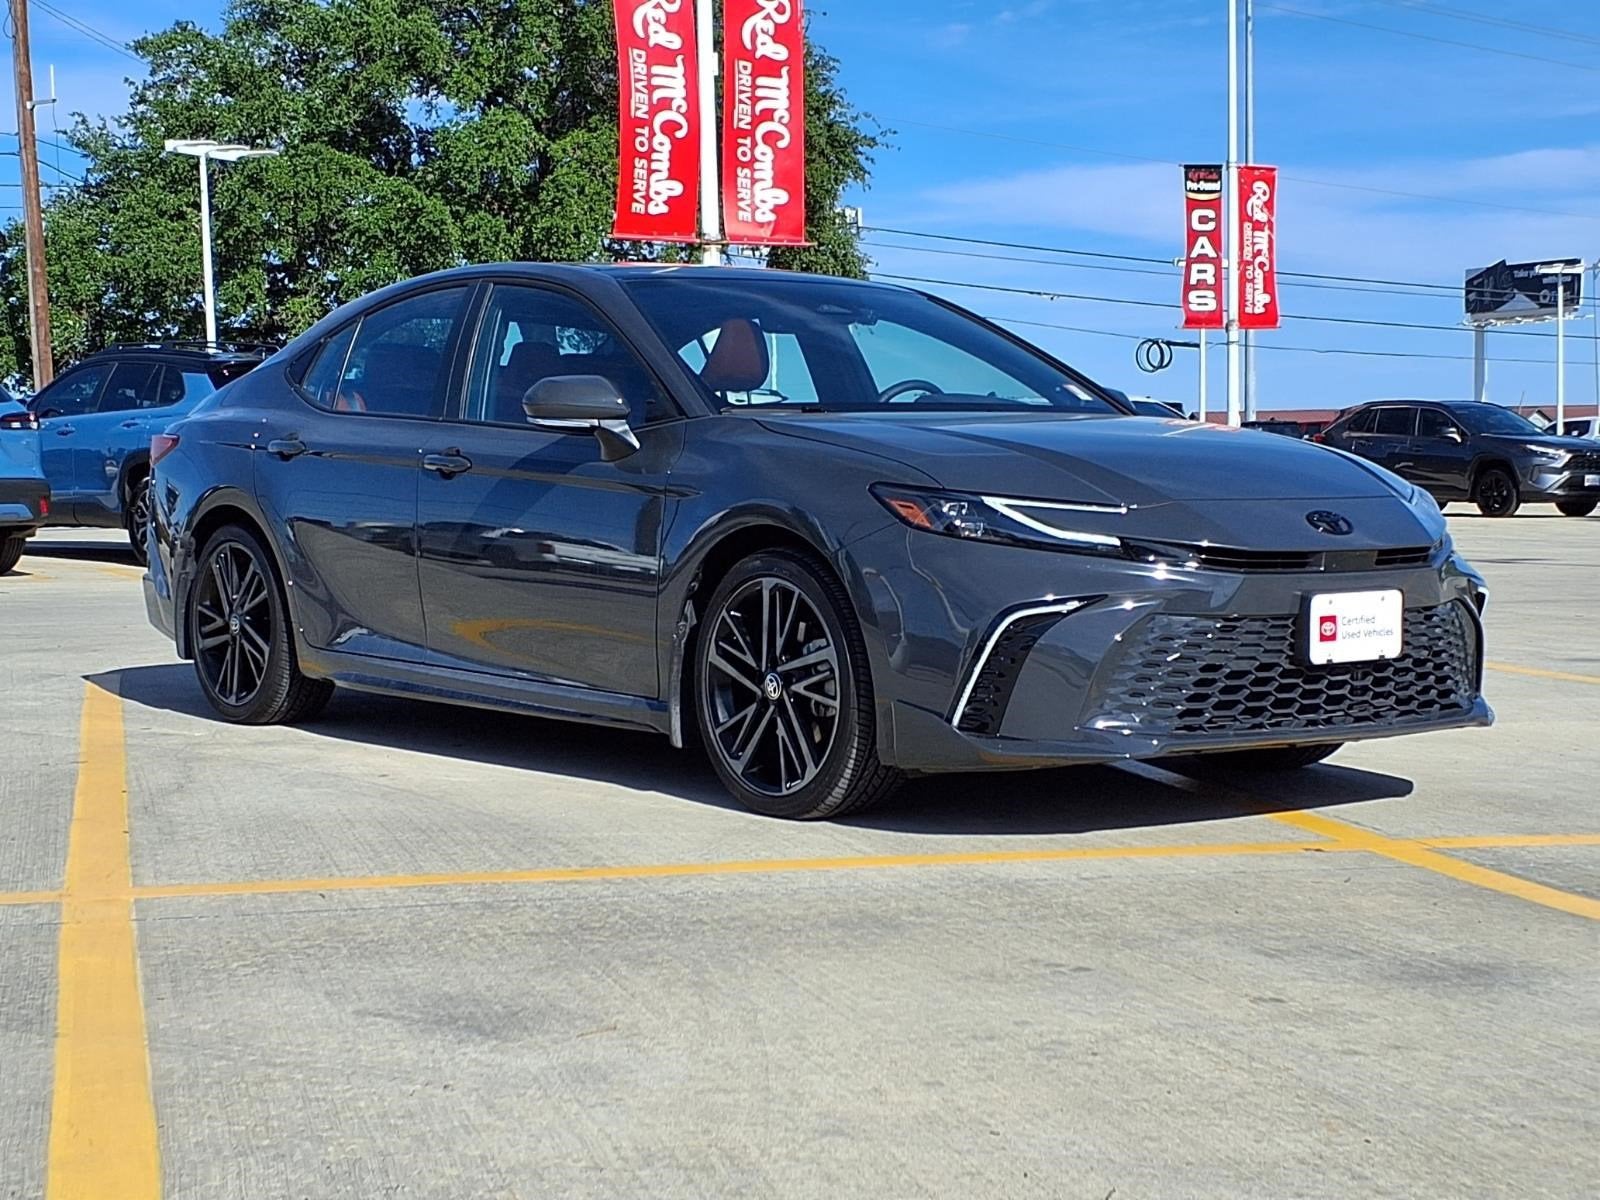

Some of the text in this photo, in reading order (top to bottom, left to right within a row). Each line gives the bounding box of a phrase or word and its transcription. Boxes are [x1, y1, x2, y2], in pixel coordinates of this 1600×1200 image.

[631, 48, 649, 215] DRIVEN TO SERVE
[648, 54, 688, 215] McCombs
[736, 59, 752, 223] DRIVEN TO SERVE
[742, 0, 792, 223] Red McCombs
[1188, 208, 1218, 311] CARS
[1246, 181, 1270, 223] Red
[1341, 614, 1376, 627] Certified
[1341, 627, 1394, 640] Used Vehicles
